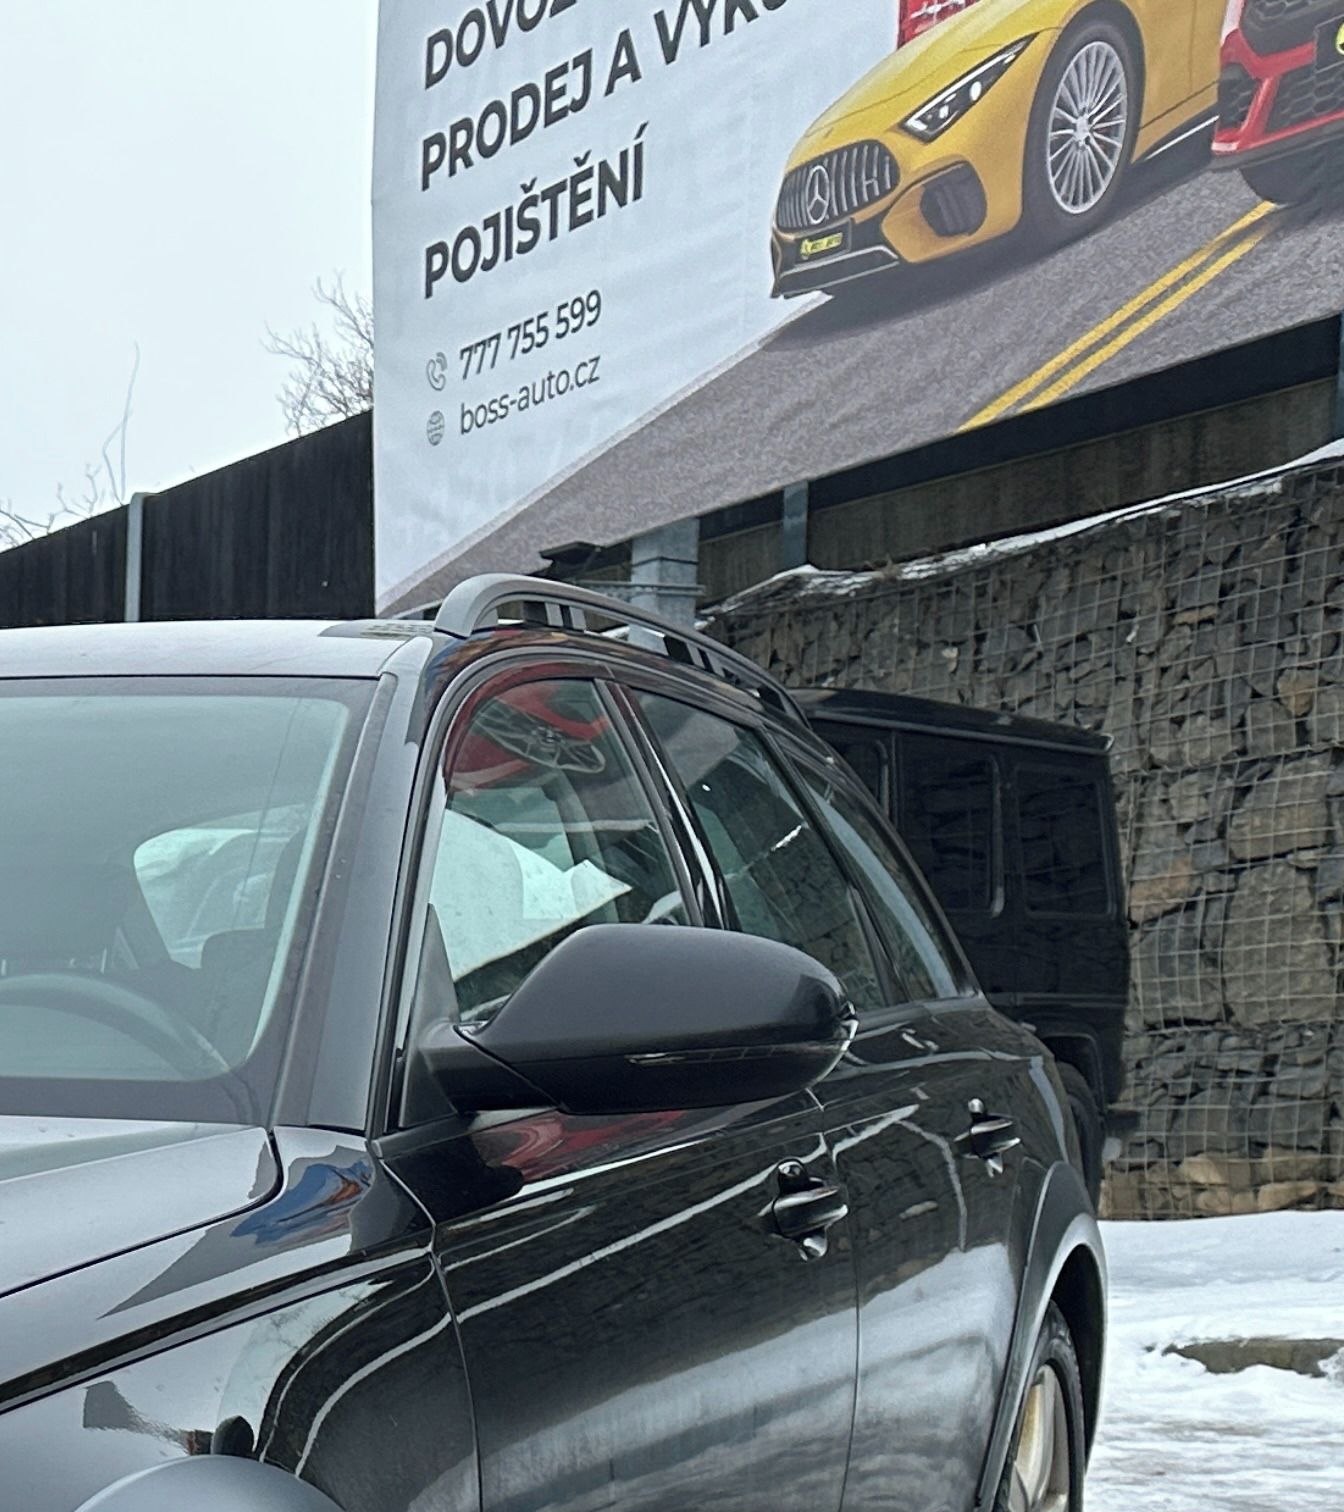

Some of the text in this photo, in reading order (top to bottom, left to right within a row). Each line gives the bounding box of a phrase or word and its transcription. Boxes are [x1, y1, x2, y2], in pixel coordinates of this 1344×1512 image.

[421, 48, 593, 192] PRODEJ
[605, 28, 642, 97] A
[424, 121, 649, 299] POJIŠTĚNÍ
[459, 289, 602, 380] 777 755 599
[461, 356, 600, 434] boss-auto.cz
